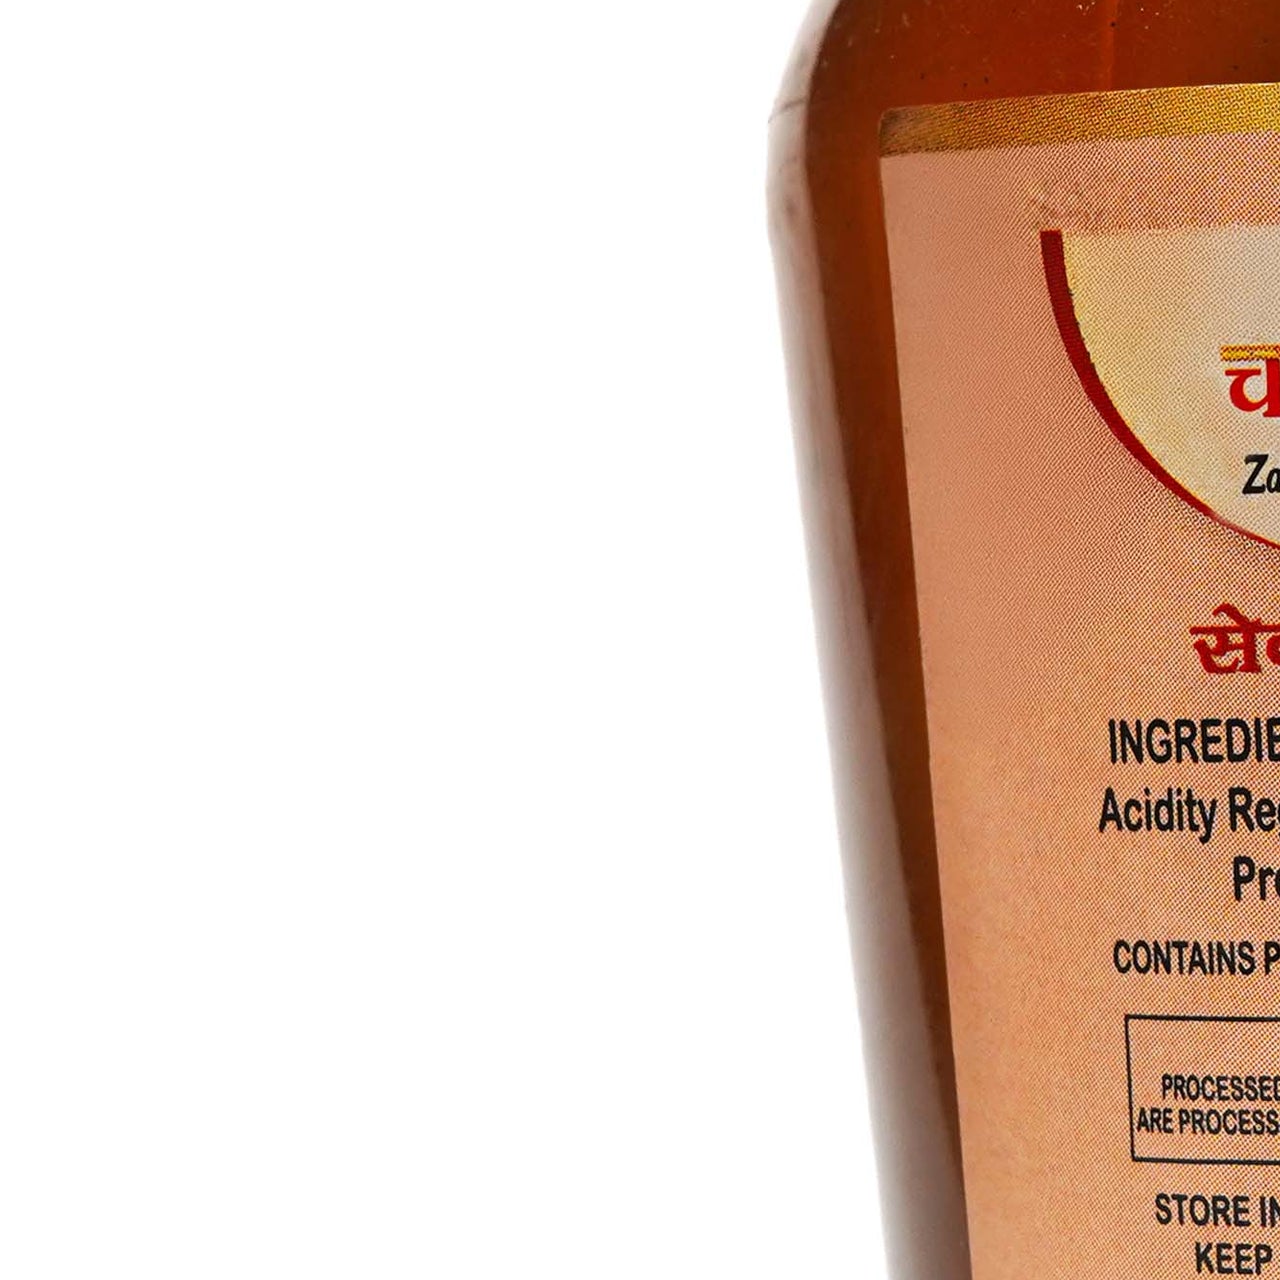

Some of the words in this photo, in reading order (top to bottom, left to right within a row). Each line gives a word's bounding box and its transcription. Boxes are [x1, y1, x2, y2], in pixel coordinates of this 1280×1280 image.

[1099, 788, 1217, 844] Acidity
[1113, 940, 1256, 975] CONTAINS
[1137, 1107, 1173, 1133] ARE
[1155, 1193, 1250, 1227] STORE
[1195, 1243, 1272, 1275] KEEP
